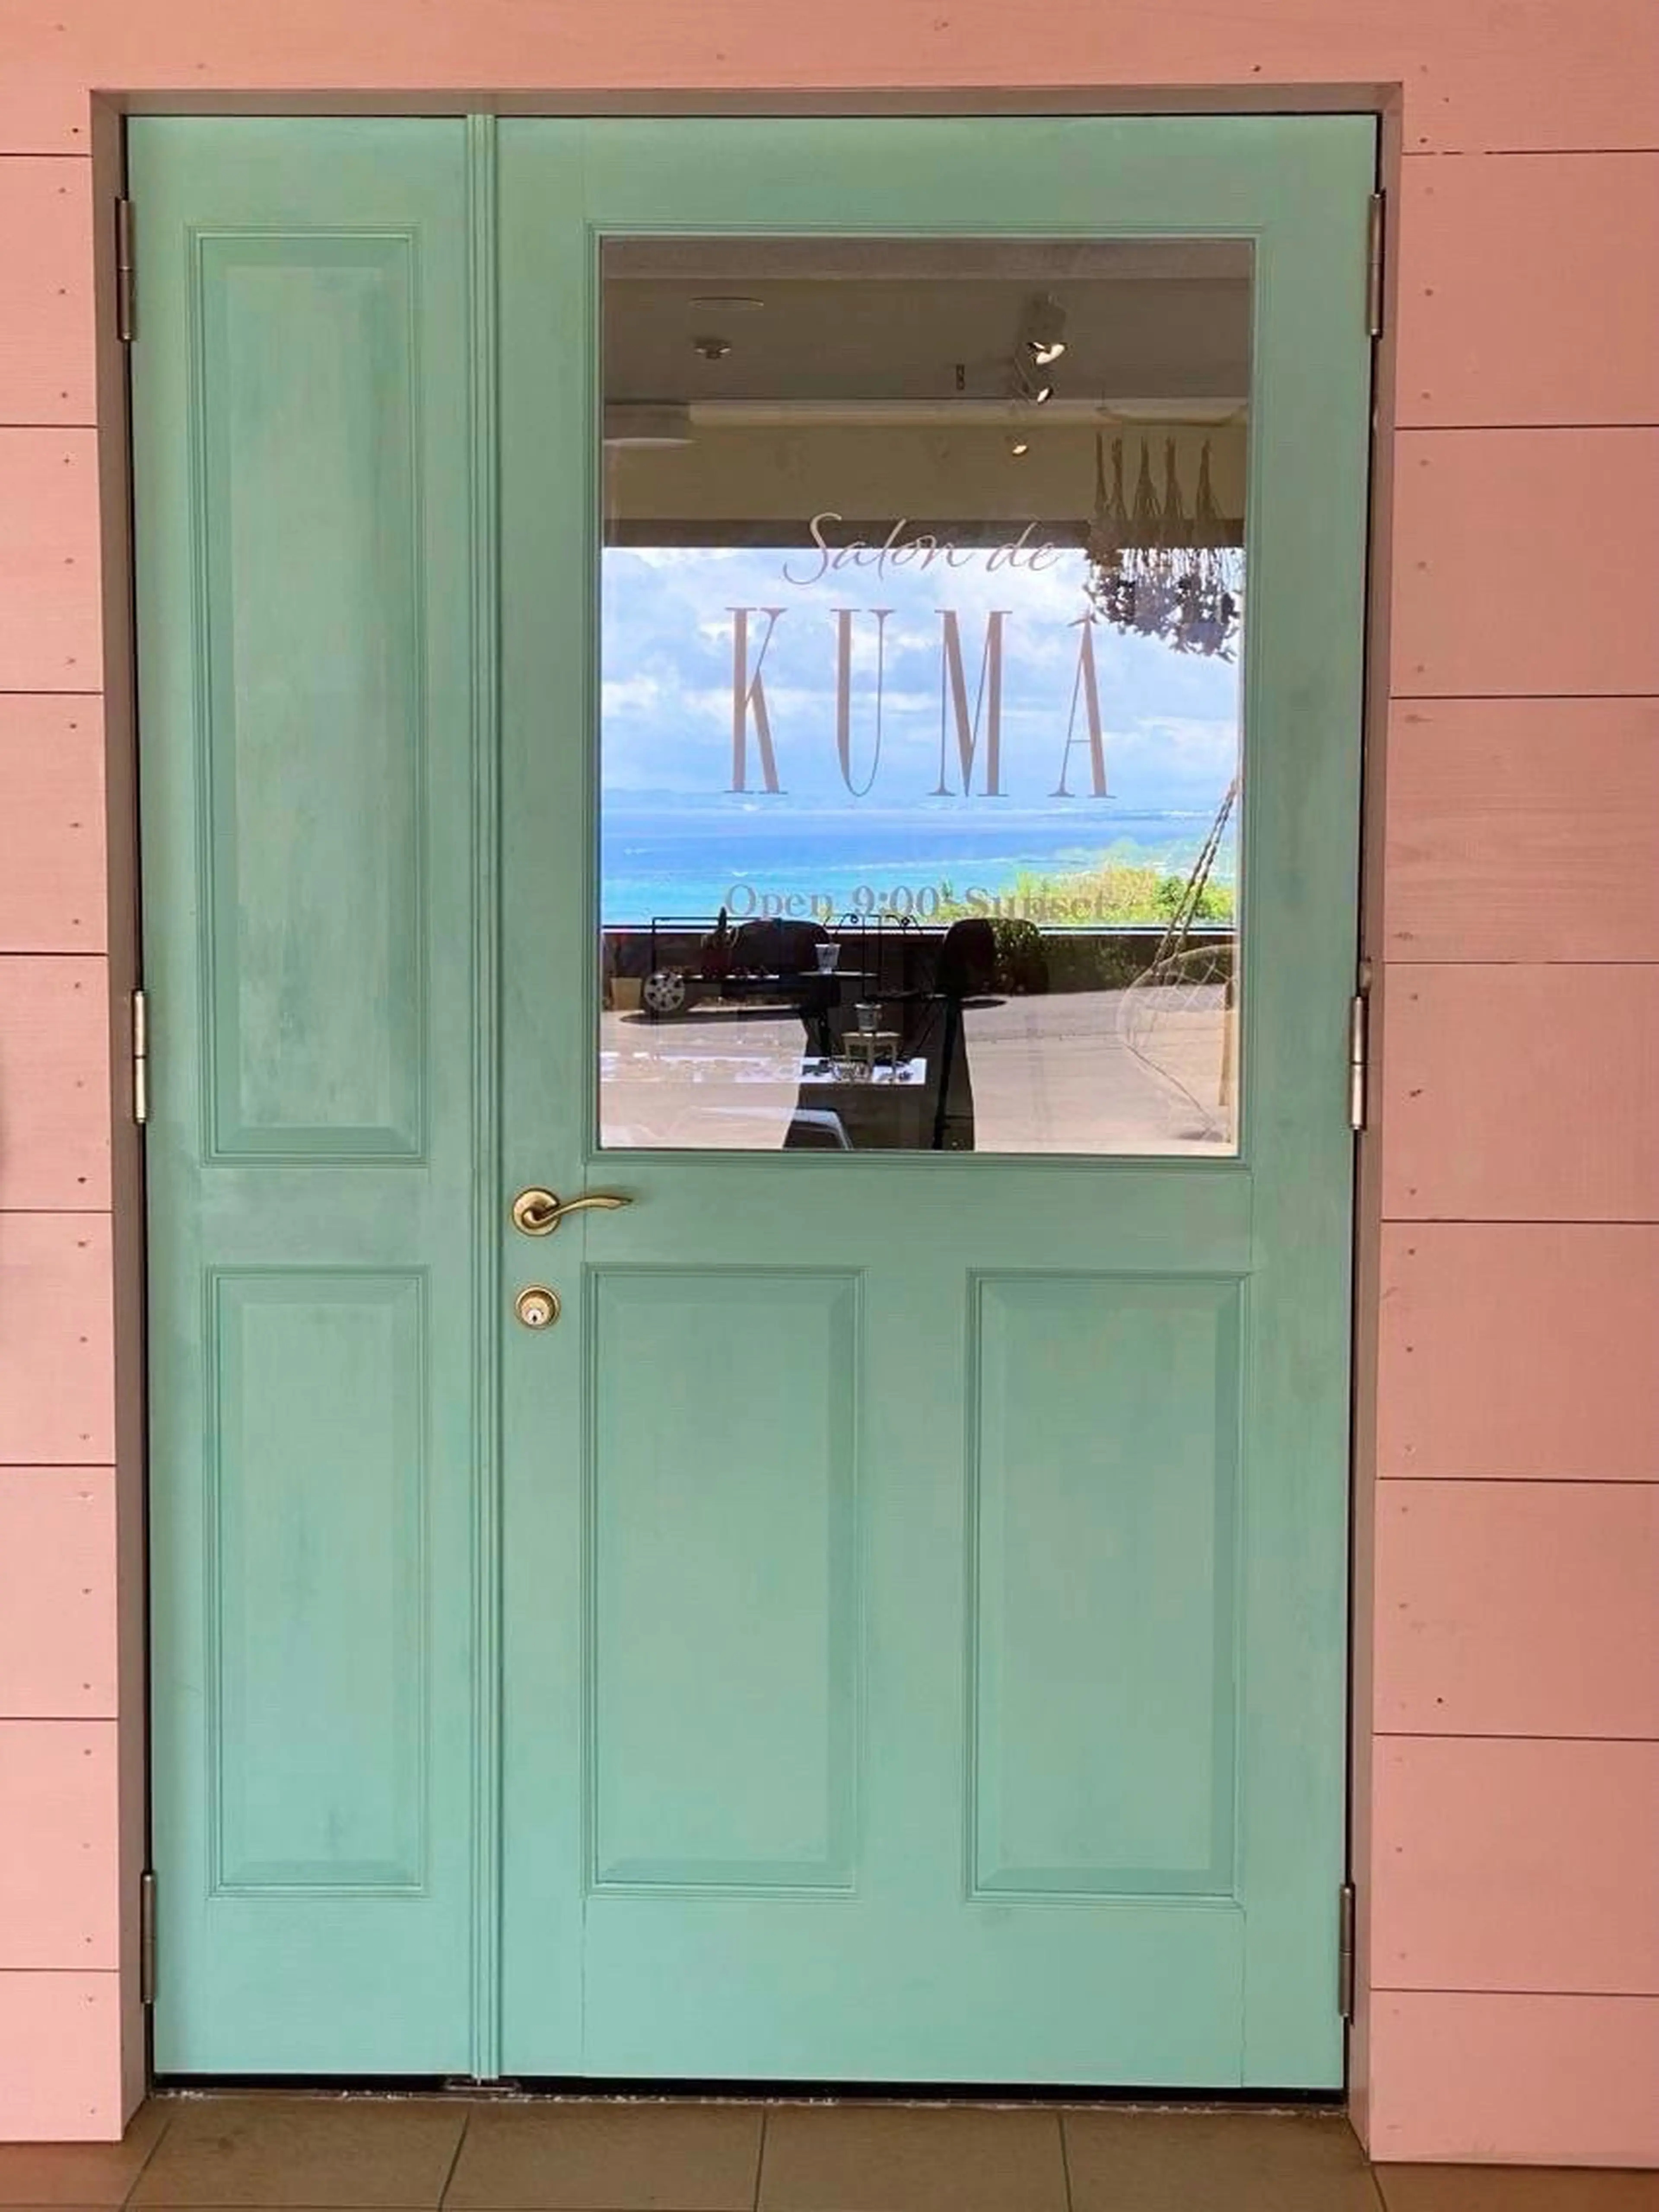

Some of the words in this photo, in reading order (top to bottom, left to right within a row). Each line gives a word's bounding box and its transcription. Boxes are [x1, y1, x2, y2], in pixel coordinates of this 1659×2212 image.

[783, 512, 974, 585] Salon
[987, 522, 1061, 571] de
[724, 607, 1117, 798] KUMA
[726, 884, 833, 918] Open
